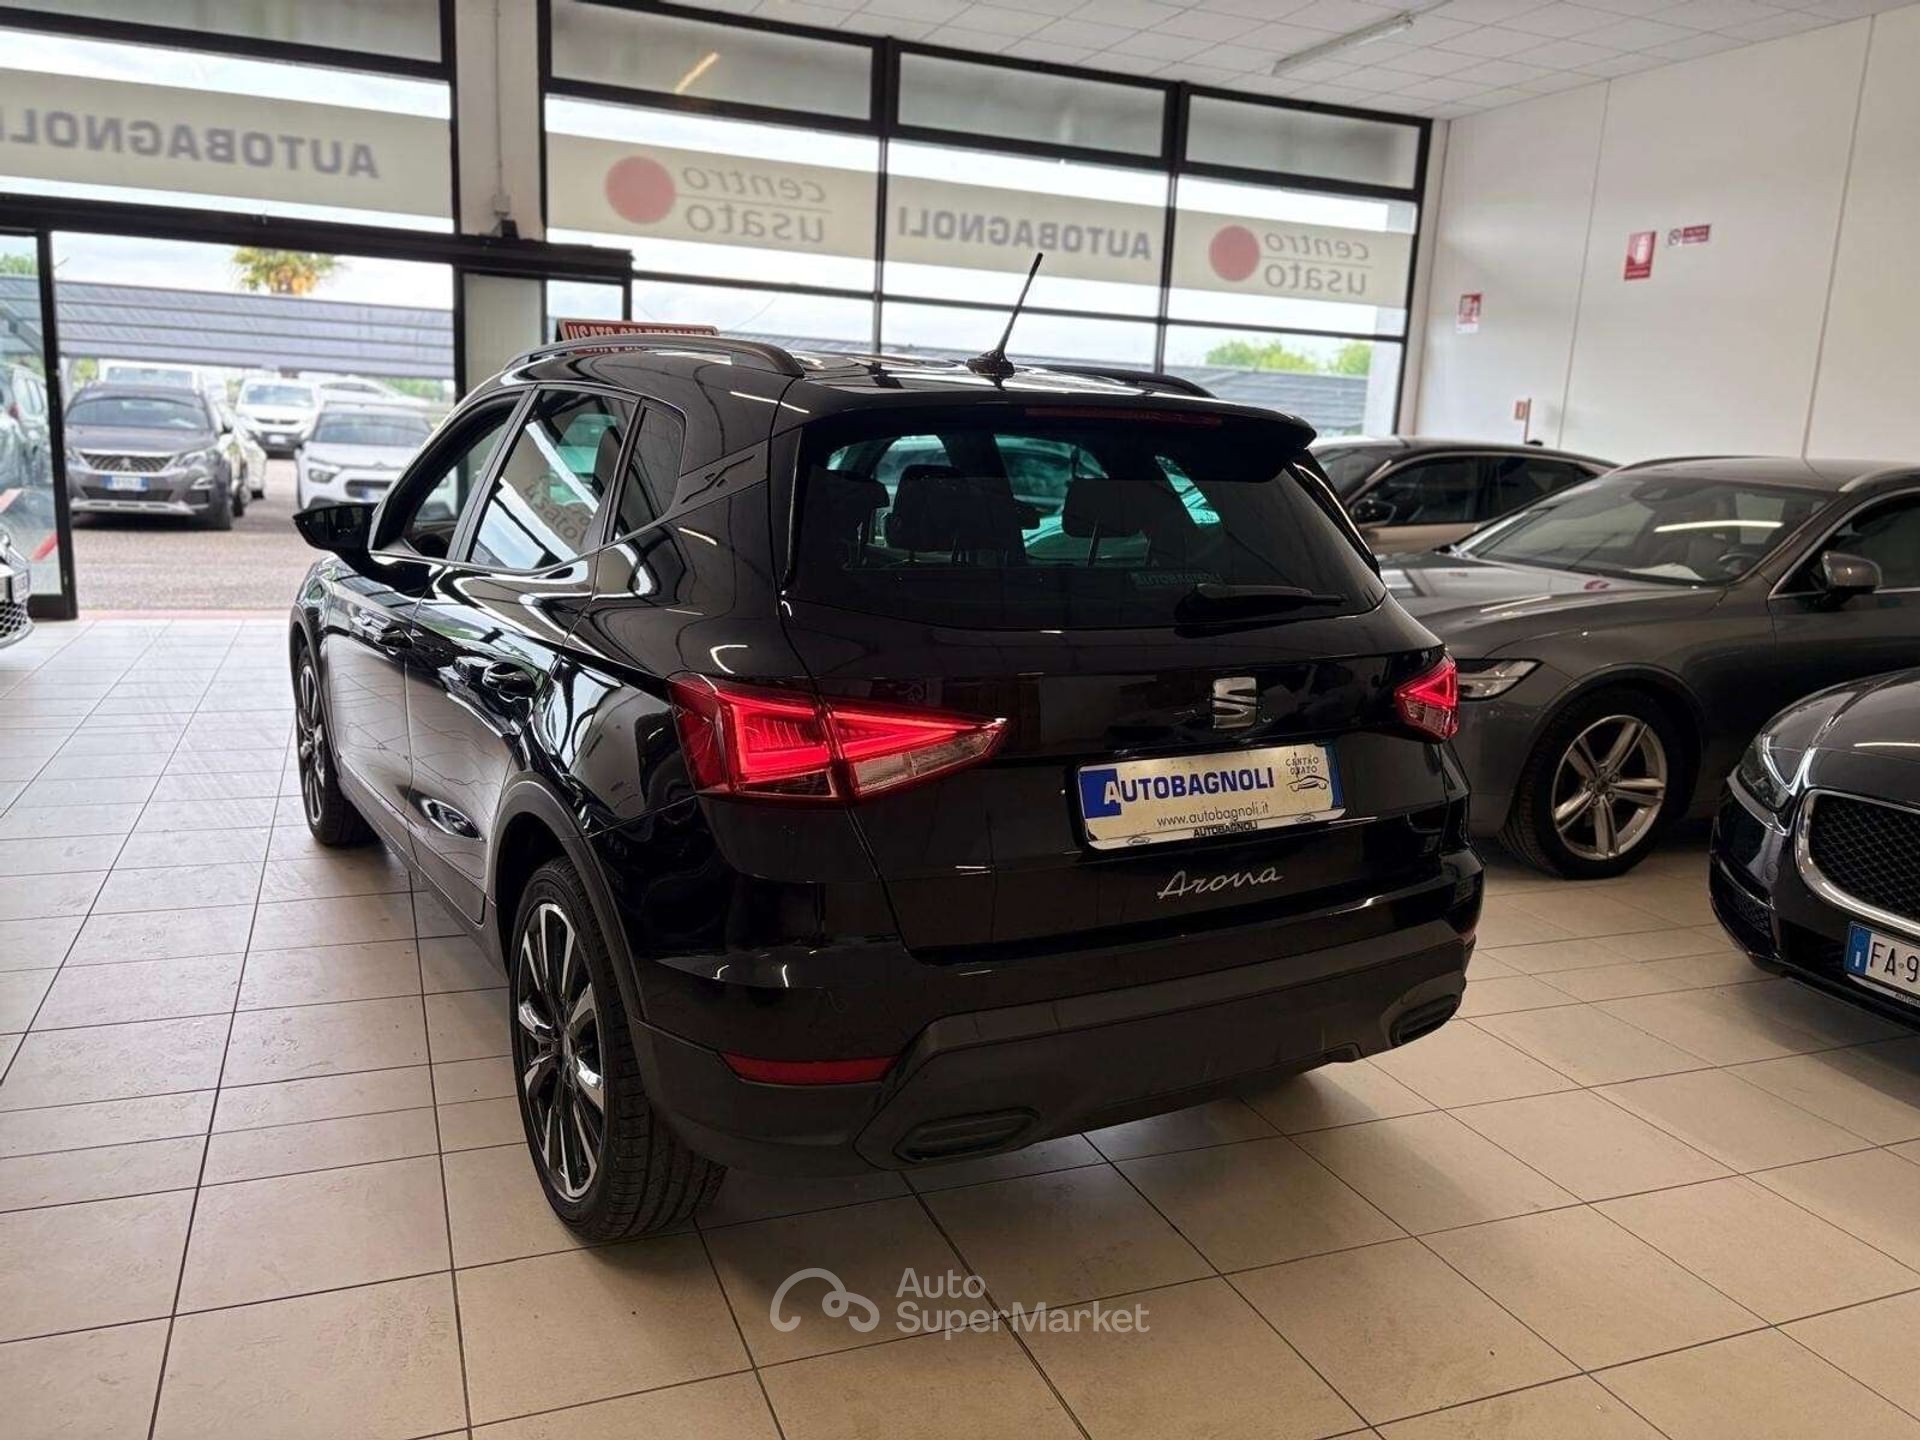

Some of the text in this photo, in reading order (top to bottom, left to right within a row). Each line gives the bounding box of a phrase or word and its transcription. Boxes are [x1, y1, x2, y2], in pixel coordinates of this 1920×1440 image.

[1104, 766, 1275, 806] AUTOBAGNOLI
[1156, 802, 1269, 827] www.autobagnoli.it
[1193, 820, 1259, 838] AUTOBAGNOLI
[1157, 864, 1285, 900] Arona
